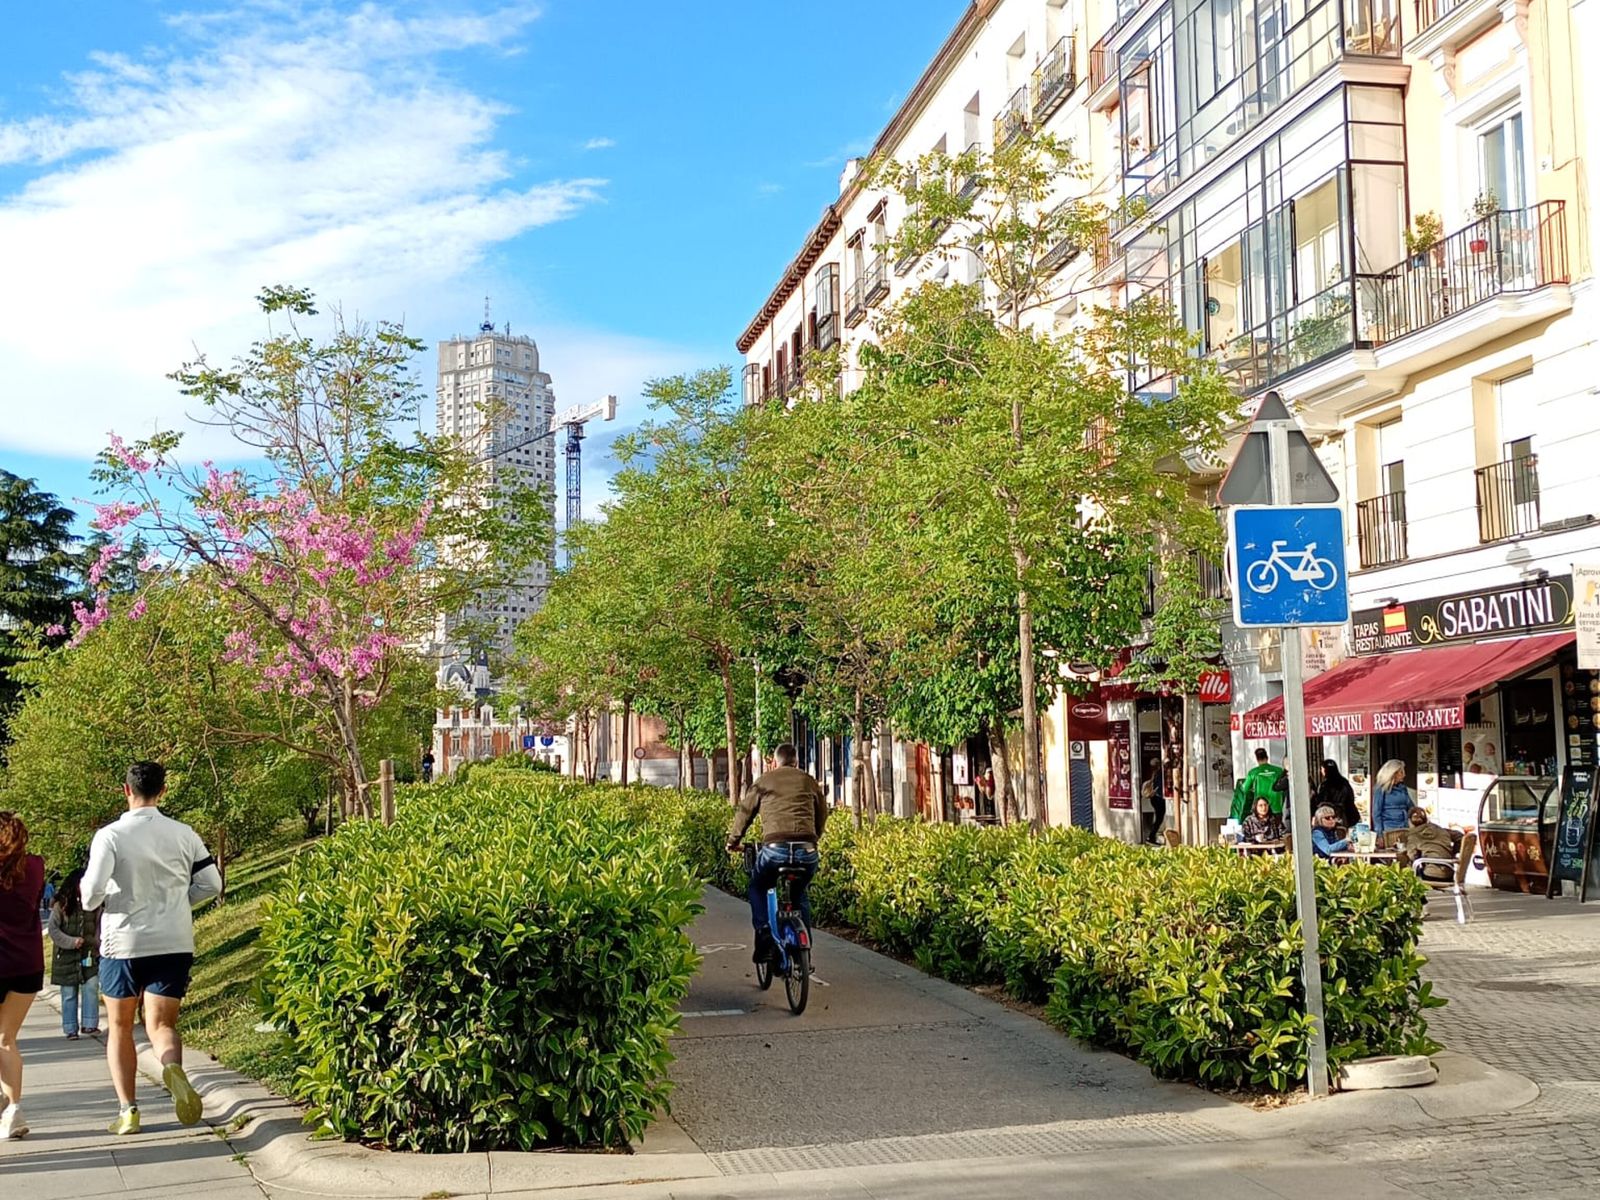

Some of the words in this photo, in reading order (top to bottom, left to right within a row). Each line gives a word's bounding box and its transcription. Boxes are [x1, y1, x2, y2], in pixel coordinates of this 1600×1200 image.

[1442, 586, 1554, 636] SABATINI
[1354, 622, 1379, 638] TAPAS
[1355, 631, 1413, 653] RESTAURANTE
[1202, 674, 1228, 699] illy
[1245, 720, 1287, 737] CERVECE
[1311, 713, 1363, 734] SABATINI
[1373, 707, 1461, 731] RESTAURANTE
